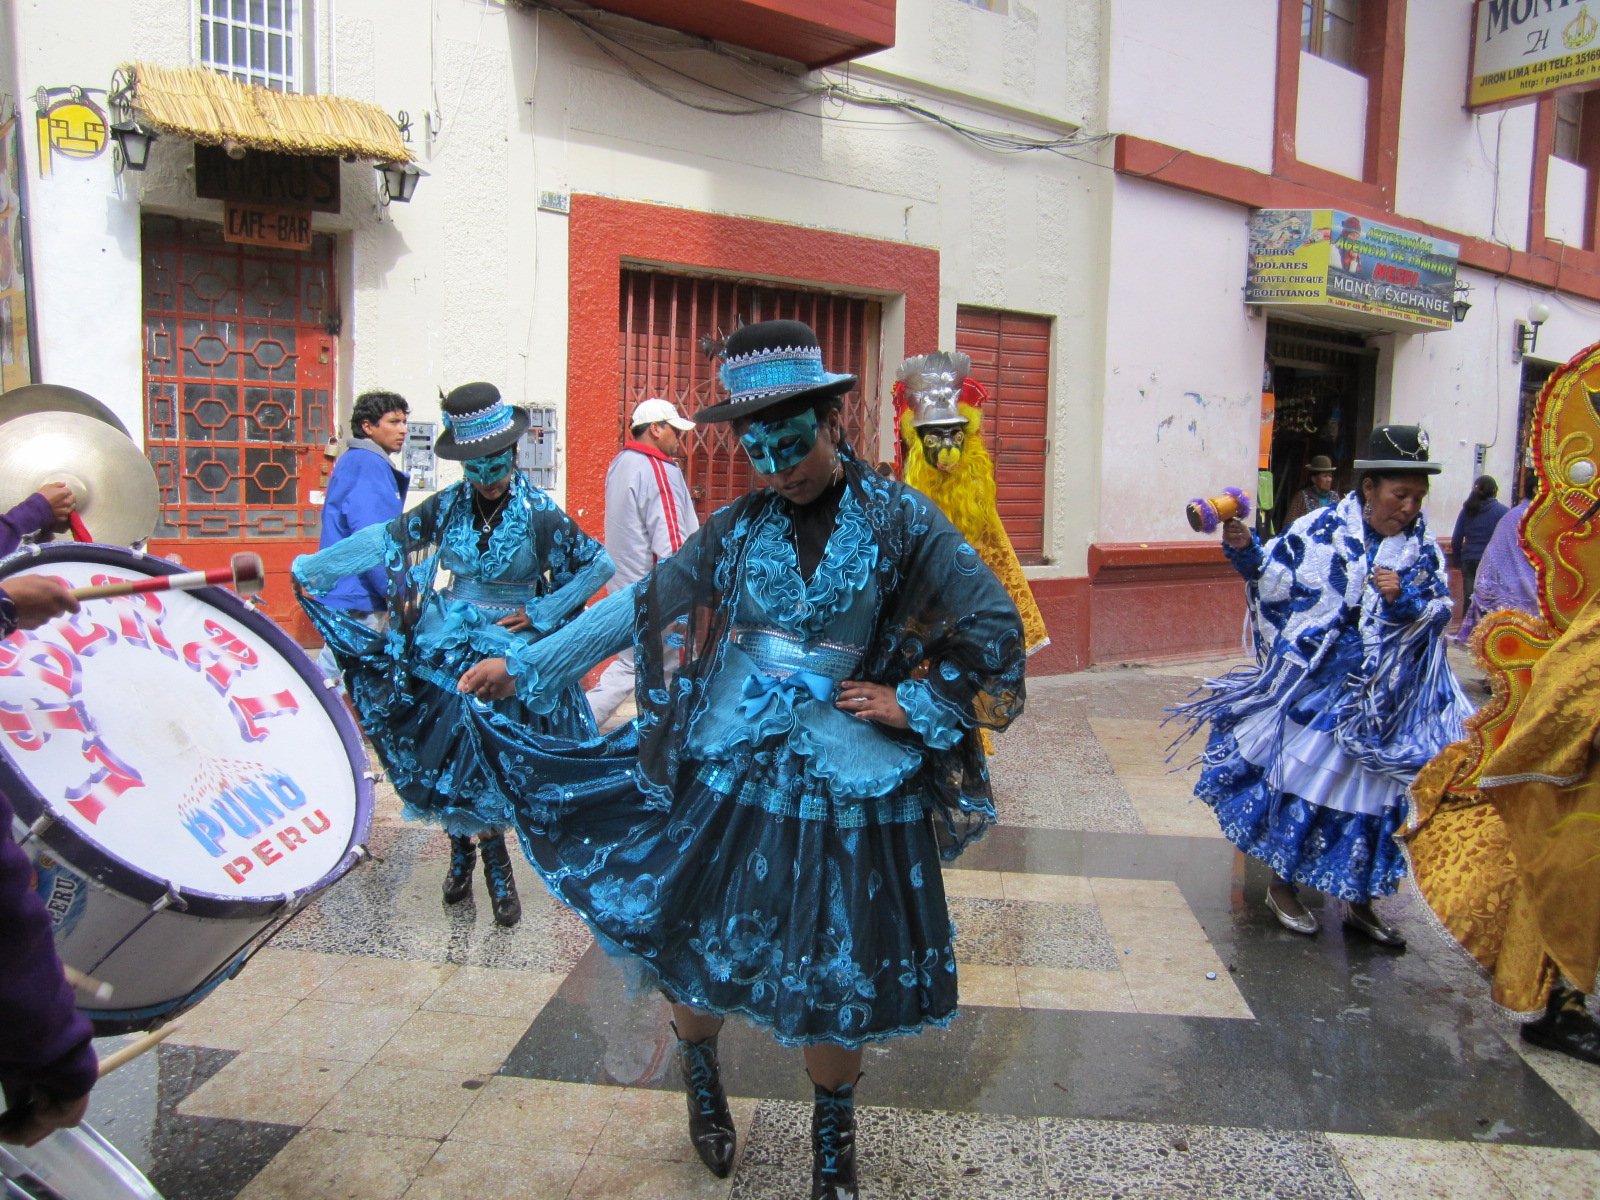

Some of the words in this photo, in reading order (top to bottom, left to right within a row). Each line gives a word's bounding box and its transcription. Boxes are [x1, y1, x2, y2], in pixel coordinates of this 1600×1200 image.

[1480, 73, 1506, 87] JIRON
[1508, 66, 1530, 80] LIMA
[1532, 62, 1547, 76] 441
[229, 208, 311, 244] CAFE-BAR
[1256, 248, 1296, 256] EUROS
[1336, 237, 1388, 260] AGENCIA
[1391, 249, 1406, 264] DE
[1408, 253, 1454, 276] CAMBIOS
[1256, 261, 1308, 270] DOLARES
[1256, 275, 1287, 283] TRAVEL
[1289, 275, 1324, 284] CHEQUE
[1253, 289, 1320, 298] BOLIVIANOS
[1385, 287, 1450, 313] EXCHANGE
[180, 768, 307, 858] PUNO
[222, 809, 331, 885] PERU
